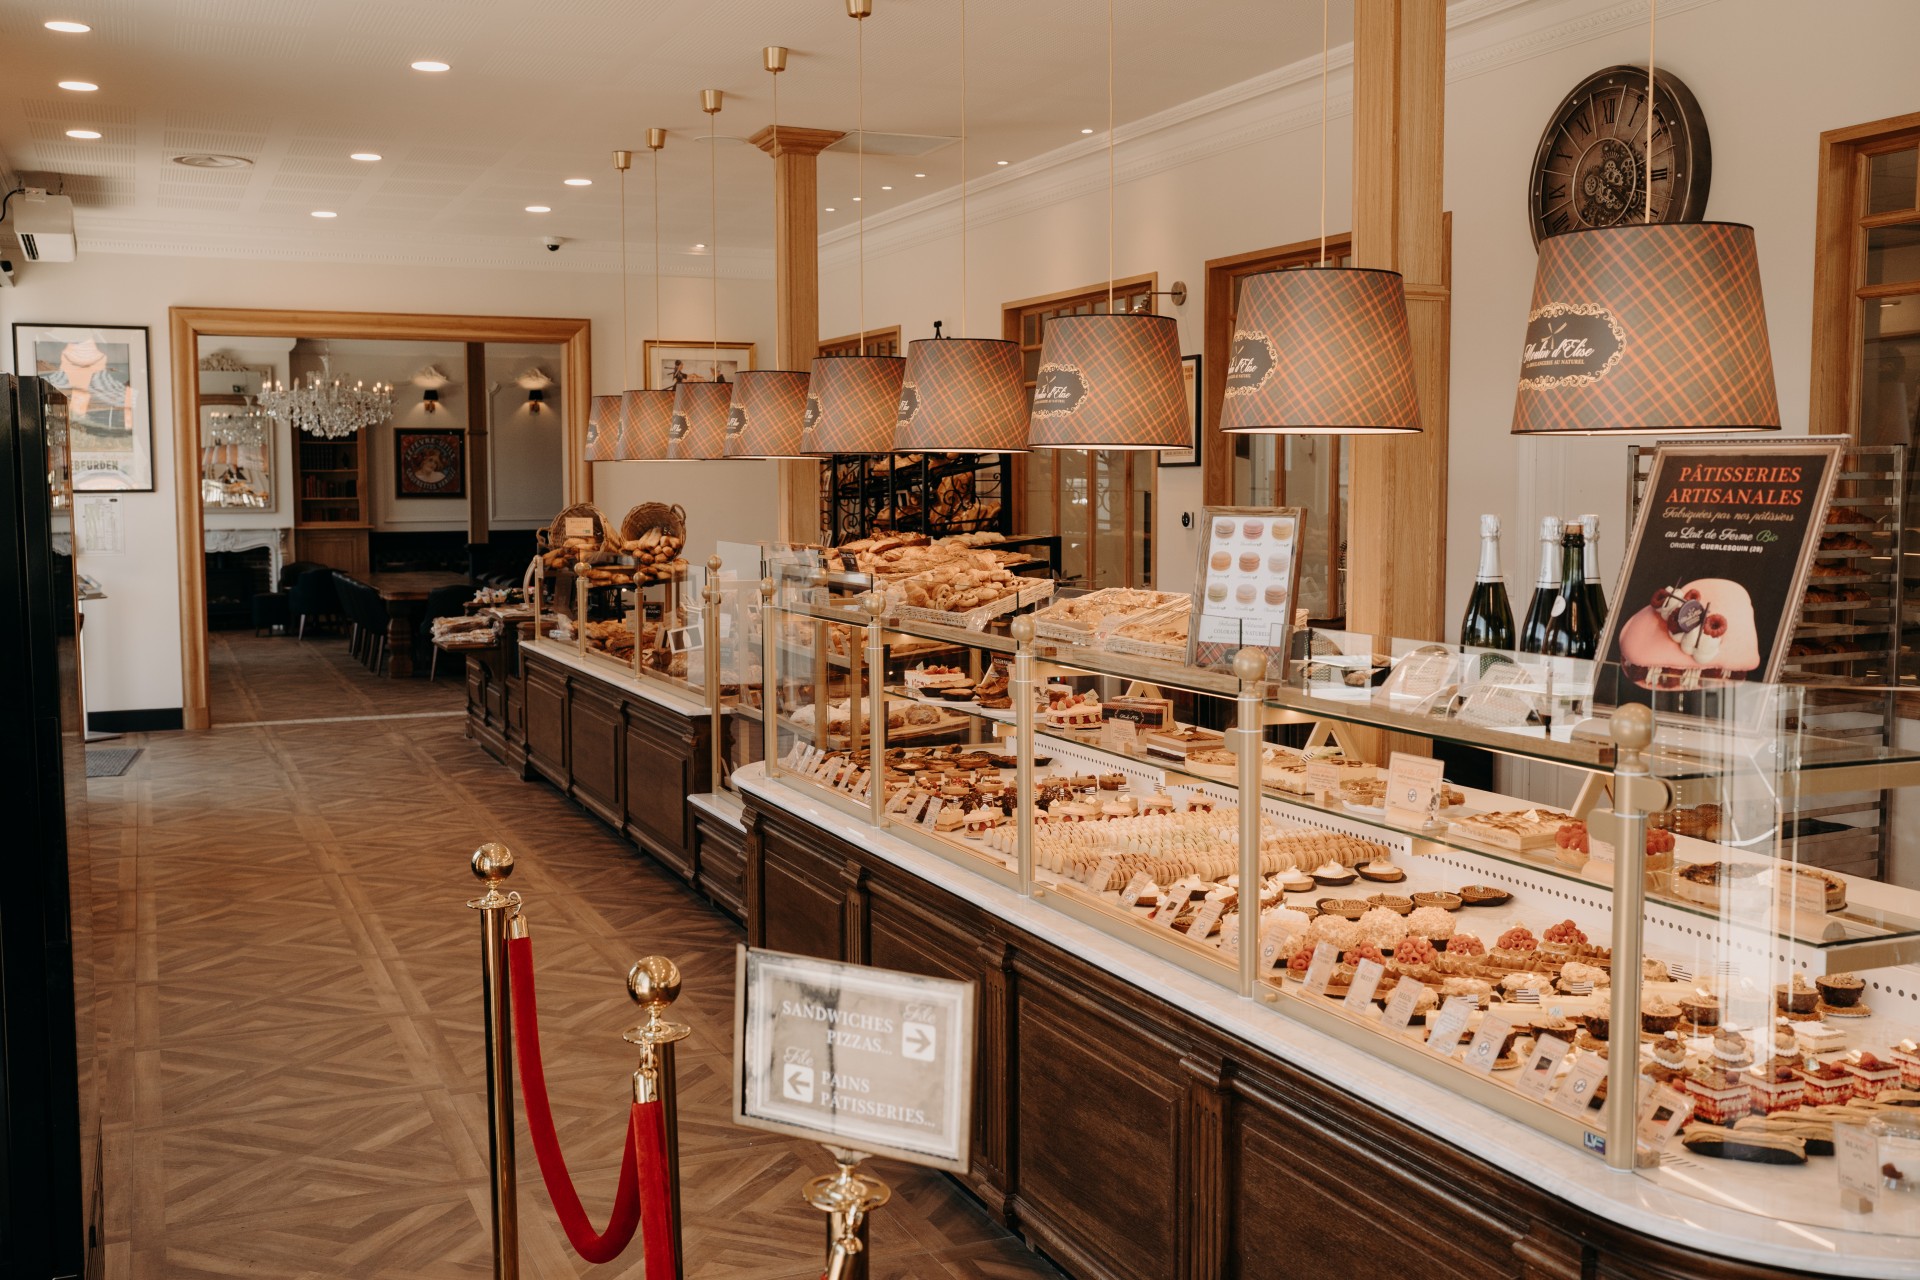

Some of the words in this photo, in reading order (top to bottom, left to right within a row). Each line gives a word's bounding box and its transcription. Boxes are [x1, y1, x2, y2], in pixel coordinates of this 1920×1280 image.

[1678, 464, 1802, 483] PÂTISSERIES
[1664, 488, 1803, 506] ARTISANALES
[1710, 512, 1731, 523] par
[1734, 512, 1750, 520] nos
[1680, 527, 1704, 539] Lait
[1704, 529, 1717, 539] de
[1719, 529, 1753, 541] Ferme
[1756, 530, 1779, 542] Bio
[1700, 543, 1749, 552] GUERLESQUIN
[782, 1000, 894, 1033] SANDWICHES
[827, 1029, 893, 1055] PIZZAS...
[821, 1071, 870, 1093] PAINS
